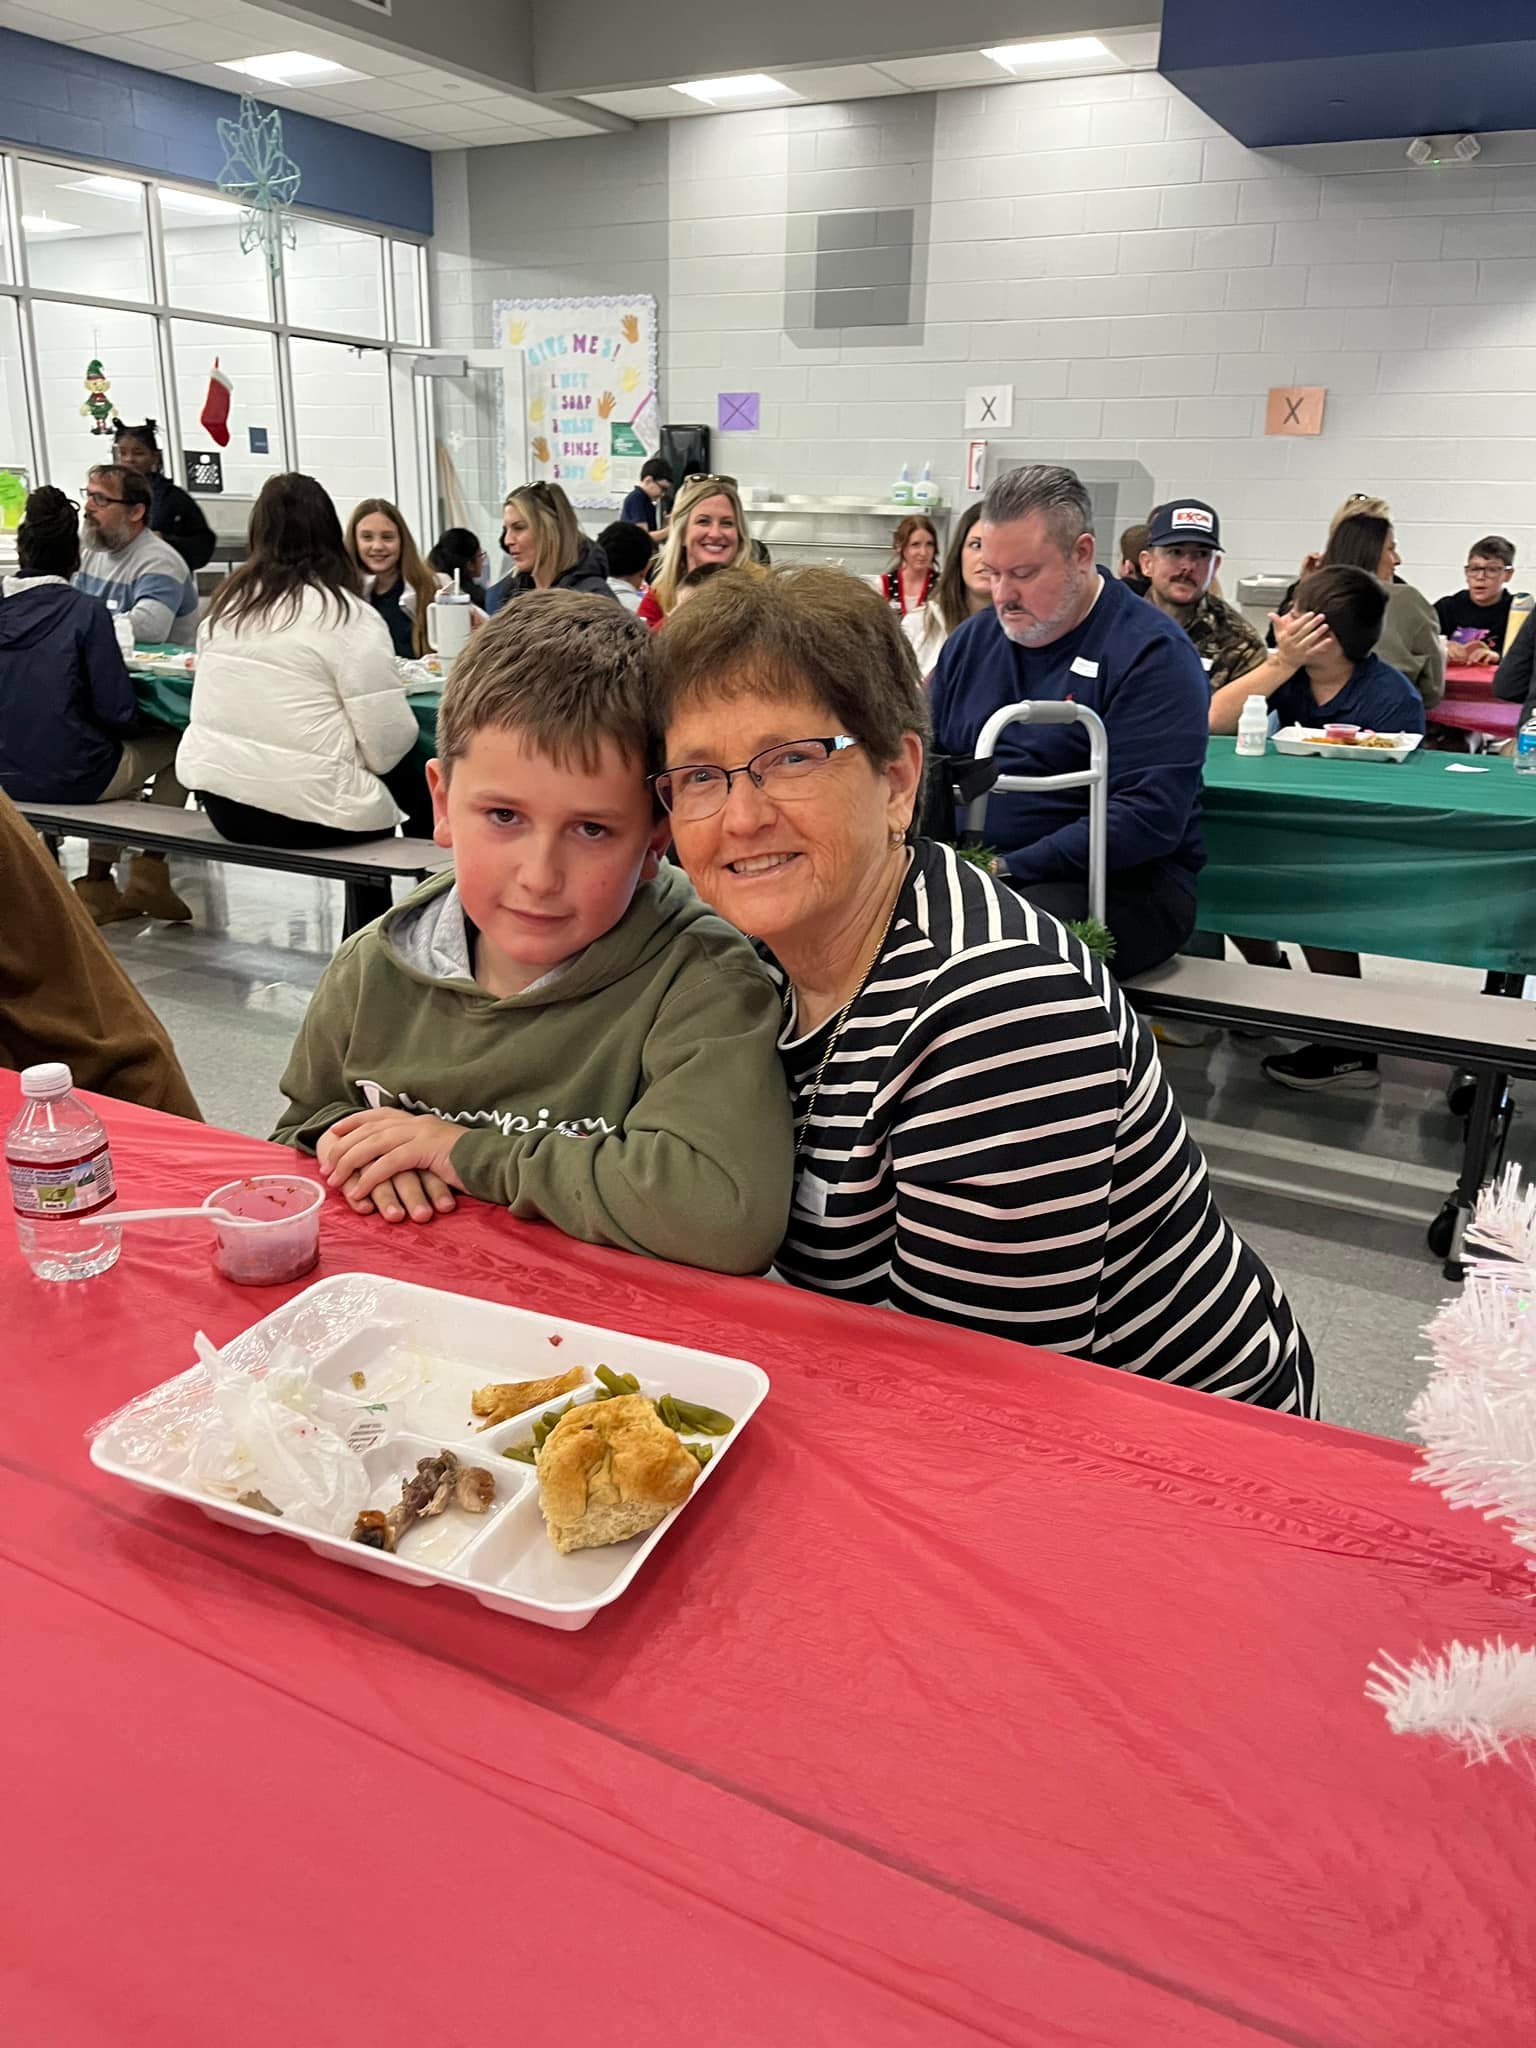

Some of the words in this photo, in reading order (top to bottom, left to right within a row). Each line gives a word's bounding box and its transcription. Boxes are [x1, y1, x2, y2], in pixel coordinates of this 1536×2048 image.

[573, 333, 599, 354] ME
[561, 395, 592, 411] SOAP
[980, 396, 997, 422] X
[1282, 396, 1305, 425] X
[563, 441, 599, 456] RINSE
